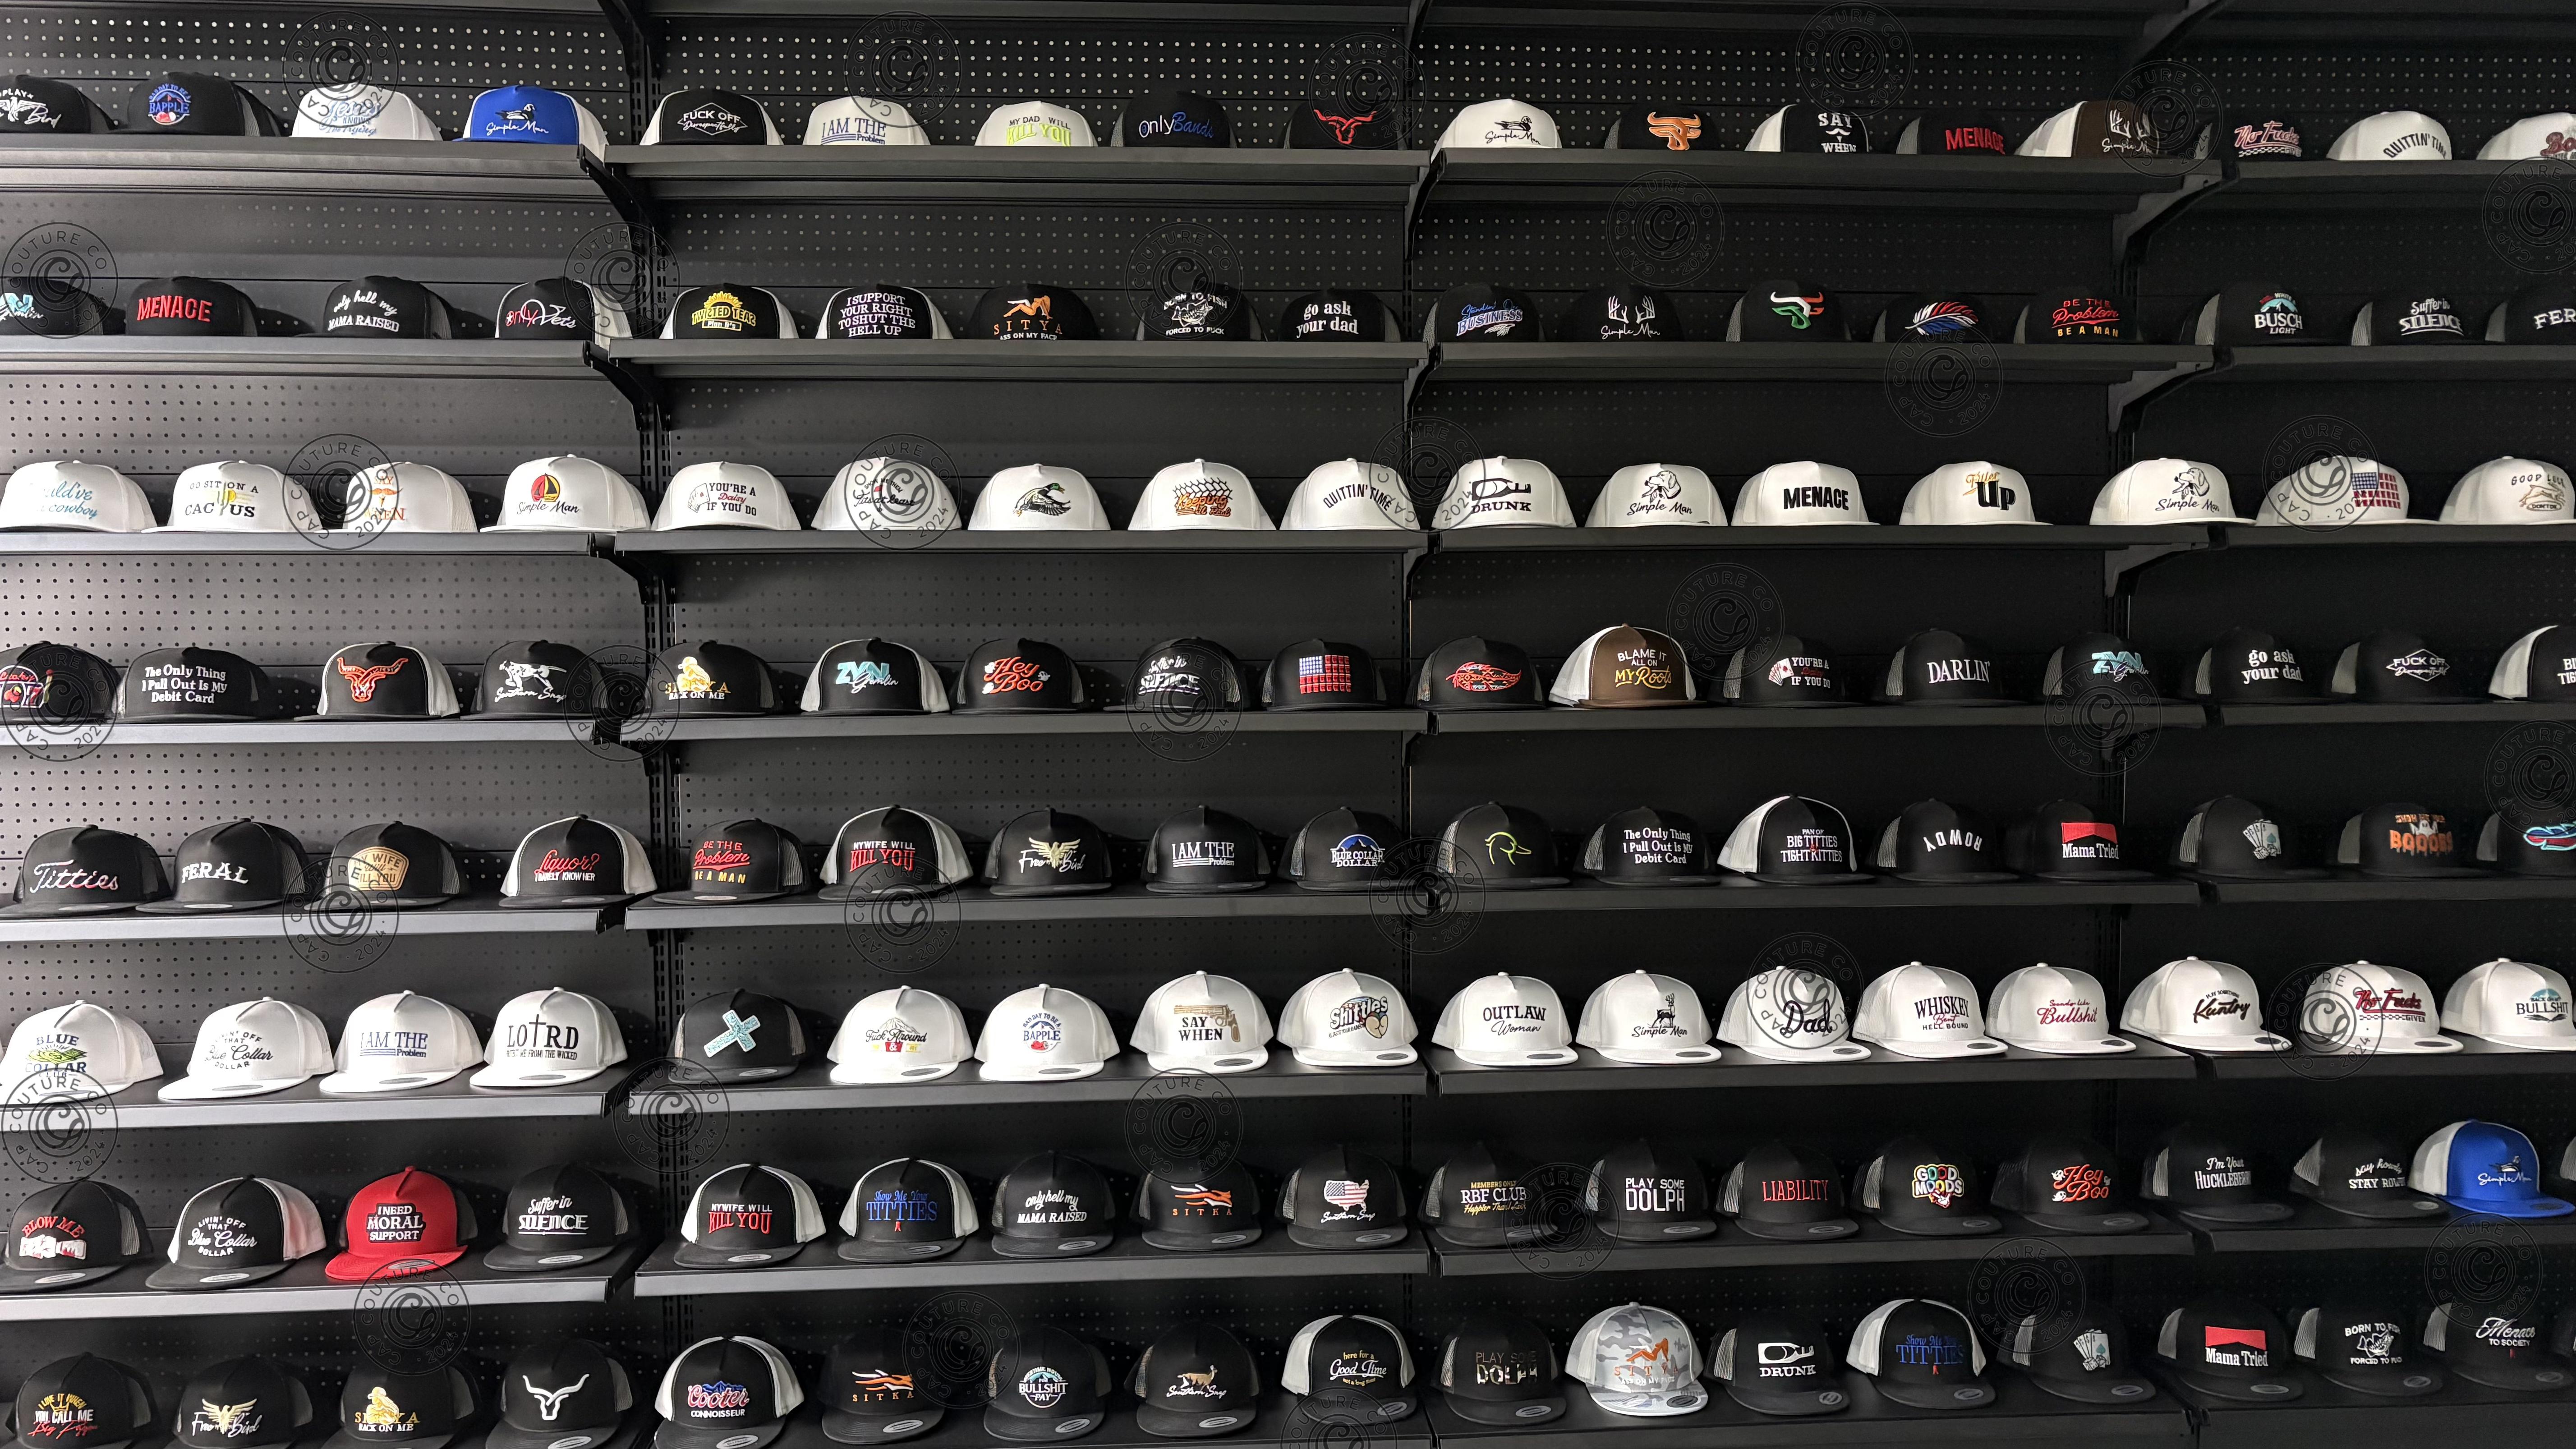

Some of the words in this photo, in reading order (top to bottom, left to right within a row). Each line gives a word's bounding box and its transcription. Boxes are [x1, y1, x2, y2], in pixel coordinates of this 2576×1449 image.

[149, 102, 189, 113] BAPPLE
[683, 110, 714, 120] FUCK
[719, 112, 741, 123] OFF
[1049, 117, 1071, 129] WILL
[1818, 113, 1853, 128] SAY
[518, 120, 548, 133] Man
[827, 117, 849, 133] AM
[855, 118, 886, 137] THE
[1486, 131, 1519, 144] Simple
[2383, 133, 2430, 158] QUITTIN'
[137, 295, 212, 322] MENACE
[840, 305, 869, 317] YOUR
[872, 304, 912, 317] RIGHT
[1304, 304, 1318, 320] go
[1324, 301, 1352, 316] ask
[2411, 298, 2441, 315] Suffer
[692, 306, 731, 325] TWISTED
[852, 314, 887, 327] SHUT
[890, 315, 915, 328] THE
[1457, 309, 1523, 336] BUSINESS
[356, 315, 400, 332] RAISED
[1296, 319, 1326, 338] your
[1330, 317, 1359, 334] dad
[848, 325, 880, 337] HELL
[884, 325, 902, 336] UP
[1601, 326, 1633, 339] Simple
[2094, 327, 2118, 337] MAN
[1177, 493, 1228, 512] Keeping
[1323, 484, 1368, 508] QUITTIN'
[1783, 487, 1849, 510] MENACE
[49, 503, 97, 520] cowboy
[550, 501, 579, 514] Man
[722, 502, 741, 512] YOU
[1471, 501, 1532, 514] DRUNK
[1627, 500, 1667, 515] Simple
[2155, 498, 2199, 511] Simple
[1617, 649, 1656, 662] BLAME
[2092, 651, 2142, 674] ZYN
[2249, 650, 2268, 667] go
[2393, 657, 2427, 667] FUCK
[164, 665, 192, 677] Only
[196, 667, 226, 681] Thing
[836, 661, 889, 685] ZYN
[984, 657, 1040, 681] Hey
[1927, 659, 1990, 683] DARLIN'
[2241, 667, 2279, 684] your
[171, 679, 196, 690] Out
[1791, 676, 1801, 685] IF
[152, 692, 181, 703] Debit
[185, 691, 215, 703] Card
[1643, 828, 1668, 839] Only
[718, 841, 742, 851] THE
[891, 842, 915, 850] WILL
[1651, 841, 1672, 851] Out
[1787, 835, 1803, 848] BIG
[1180, 842, 1201, 858] AM
[1205, 842, 1234, 858] THE
[1332, 851, 1352, 863] BLUE
[2062, 844, 2096, 858] Mama
[2097, 843, 2119, 859] Tried
[373, 853, 401, 868] WIFE
[1019, 849, 1046, 873] Free
[1635, 854, 1662, 864] Debit
[1665, 852, 1686, 864] Card
[30, 859, 119, 893] Titties
[181, 862, 248, 884] FERAL
[562, 873, 582, 881] KNOW
[1330, 997, 1388, 1030] Shittles
[1483, 1006, 1546, 1021] OUTLAW
[1914, 996, 1969, 1019] WHISKEY
[2516, 1001, 2568, 1014] BULLSHIT
[1182, 1017, 1208, 1028] SAY
[1780, 998, 1833, 1035] Dad
[2037, 1007, 2097, 1024] Bullshit
[887, 1029, 927, 1043] Around
[1024, 1030, 1061, 1041] BAPPLE
[1178, 1029, 1223, 1041] WHEN
[1632, 1026, 1667, 1038] Simple
[37, 1034, 79, 1046] BLUE
[395, 1032, 428, 1049] THE
[231, 1045, 273, 1060] Collar
[545, 1050, 555, 1058] THE
[1917, 1166, 1957, 1181] GOOD
[2053, 1164, 2103, 1189] Hey
[2478, 1173, 2512, 1187] Simple
[1626, 1178, 1654, 1188] PLAY
[1660, 1179, 1684, 1189] SOME
[1762, 1180, 1828, 1201] LIABILITY
[2349, 1179, 2378, 1189] STAY
[1461, 1189, 1489, 1204] RBF
[1493, 1187, 1527, 1202] CLUB
[1626, 1188, 1684, 1212] DOLPH
[528, 1198, 559, 1214] Suffer
[866, 1201, 937, 1221] TITTIES
[226, 1218, 246, 1229] OFF
[367, 1215, 423, 1229] MORAL
[737, 1212, 772, 1233] YOU
[1049, 1212, 1086, 1223] RAISED
[22, 1216, 58, 1237] BLOW
[58, 1217, 84, 1238] ME
[370, 1231, 419, 1240] SUPPORT
[2345, 1323, 2371, 1336] BORN
[1906, 1335, 1926, 1344] Show
[1476, 1352, 1504, 1363] PLAY
[2205, 1347, 2240, 1366] Mama
[1760, 1365, 1816, 1377] DRUNK
[1019, 1382, 1068, 1393] BULLSHIT
[78, 1409, 93, 1421] ME
[690, 1409, 745, 1418] CONNOISSEUR
[228, 1413, 262, 1437] Bird
[378, 1424, 393, 1432] ON
